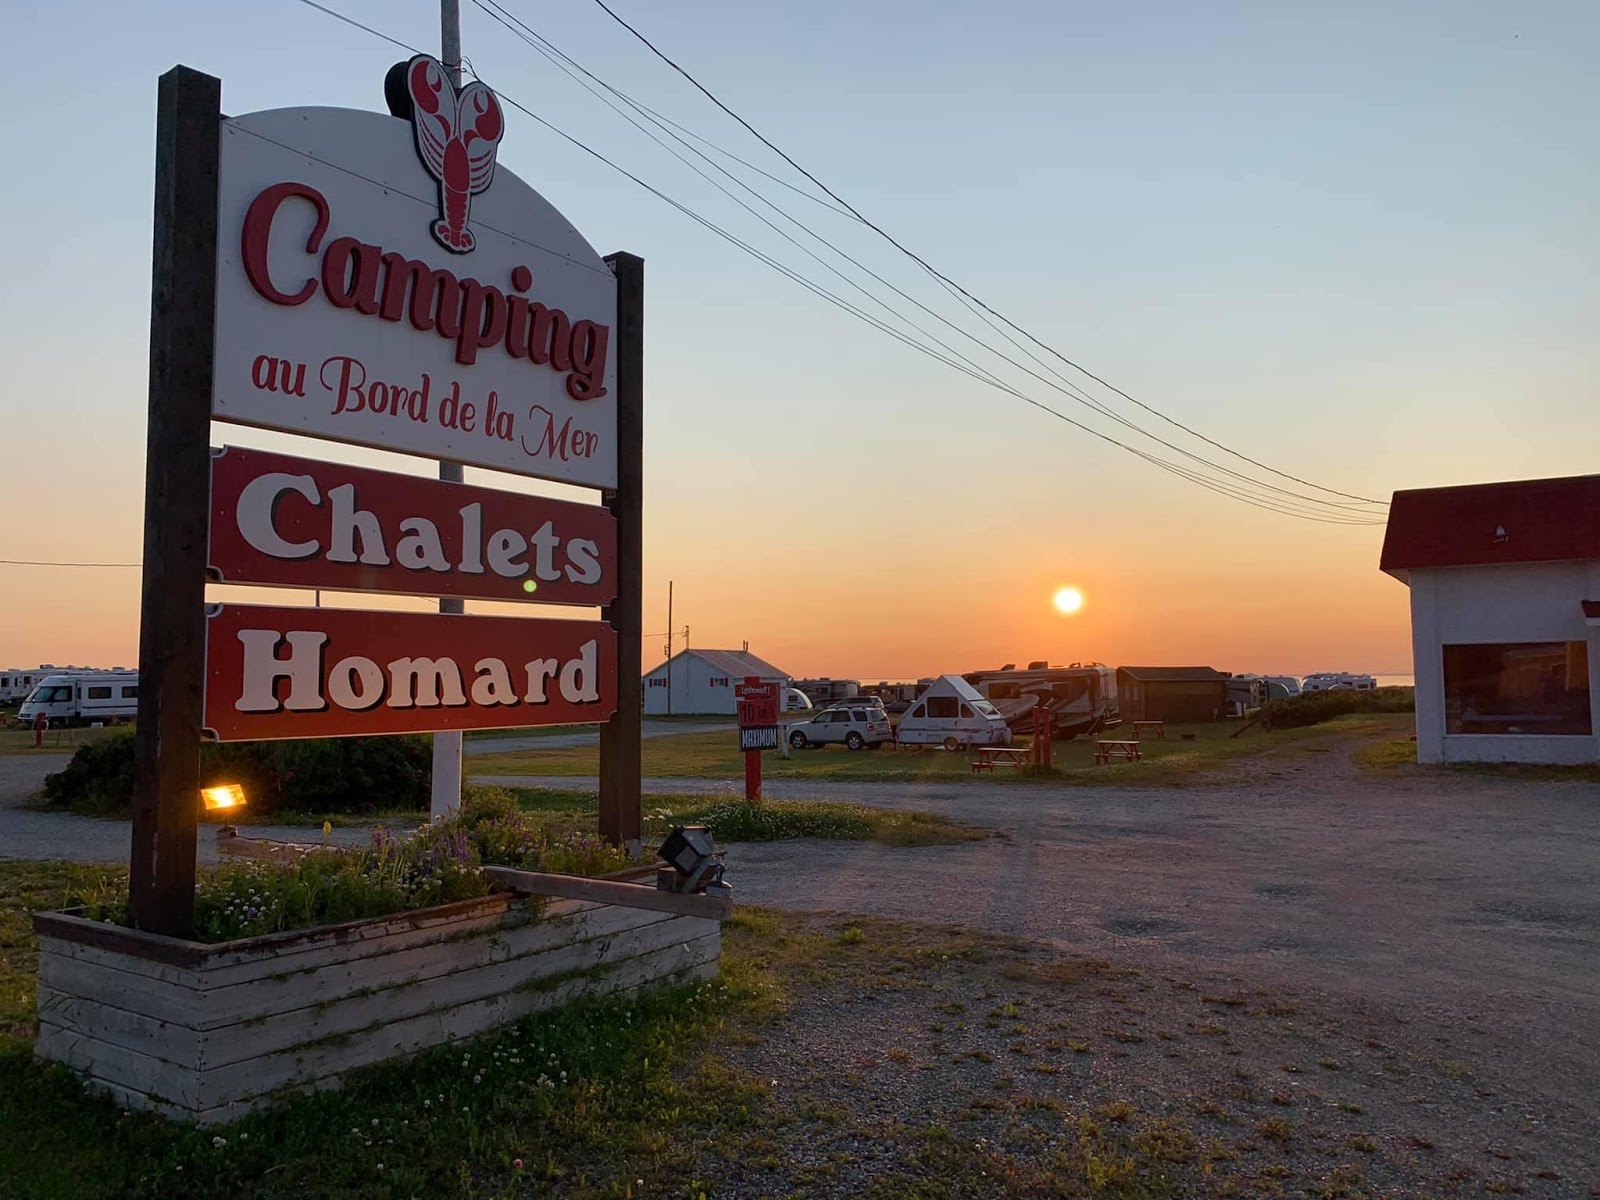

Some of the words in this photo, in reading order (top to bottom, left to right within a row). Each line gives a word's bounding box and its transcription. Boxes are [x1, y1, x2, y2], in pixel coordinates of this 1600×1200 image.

[241, 181, 609, 401] Camping
[251, 354, 307, 397] au
[319, 356, 431, 423] Bord
[438, 381, 476, 432] de
[485, 391, 514, 442] la
[520, 405, 599, 461] Mer
[236, 473, 602, 584] Chalets
[235, 628, 600, 713] Homard
[742, 728, 777, 748] MAXIMUM
